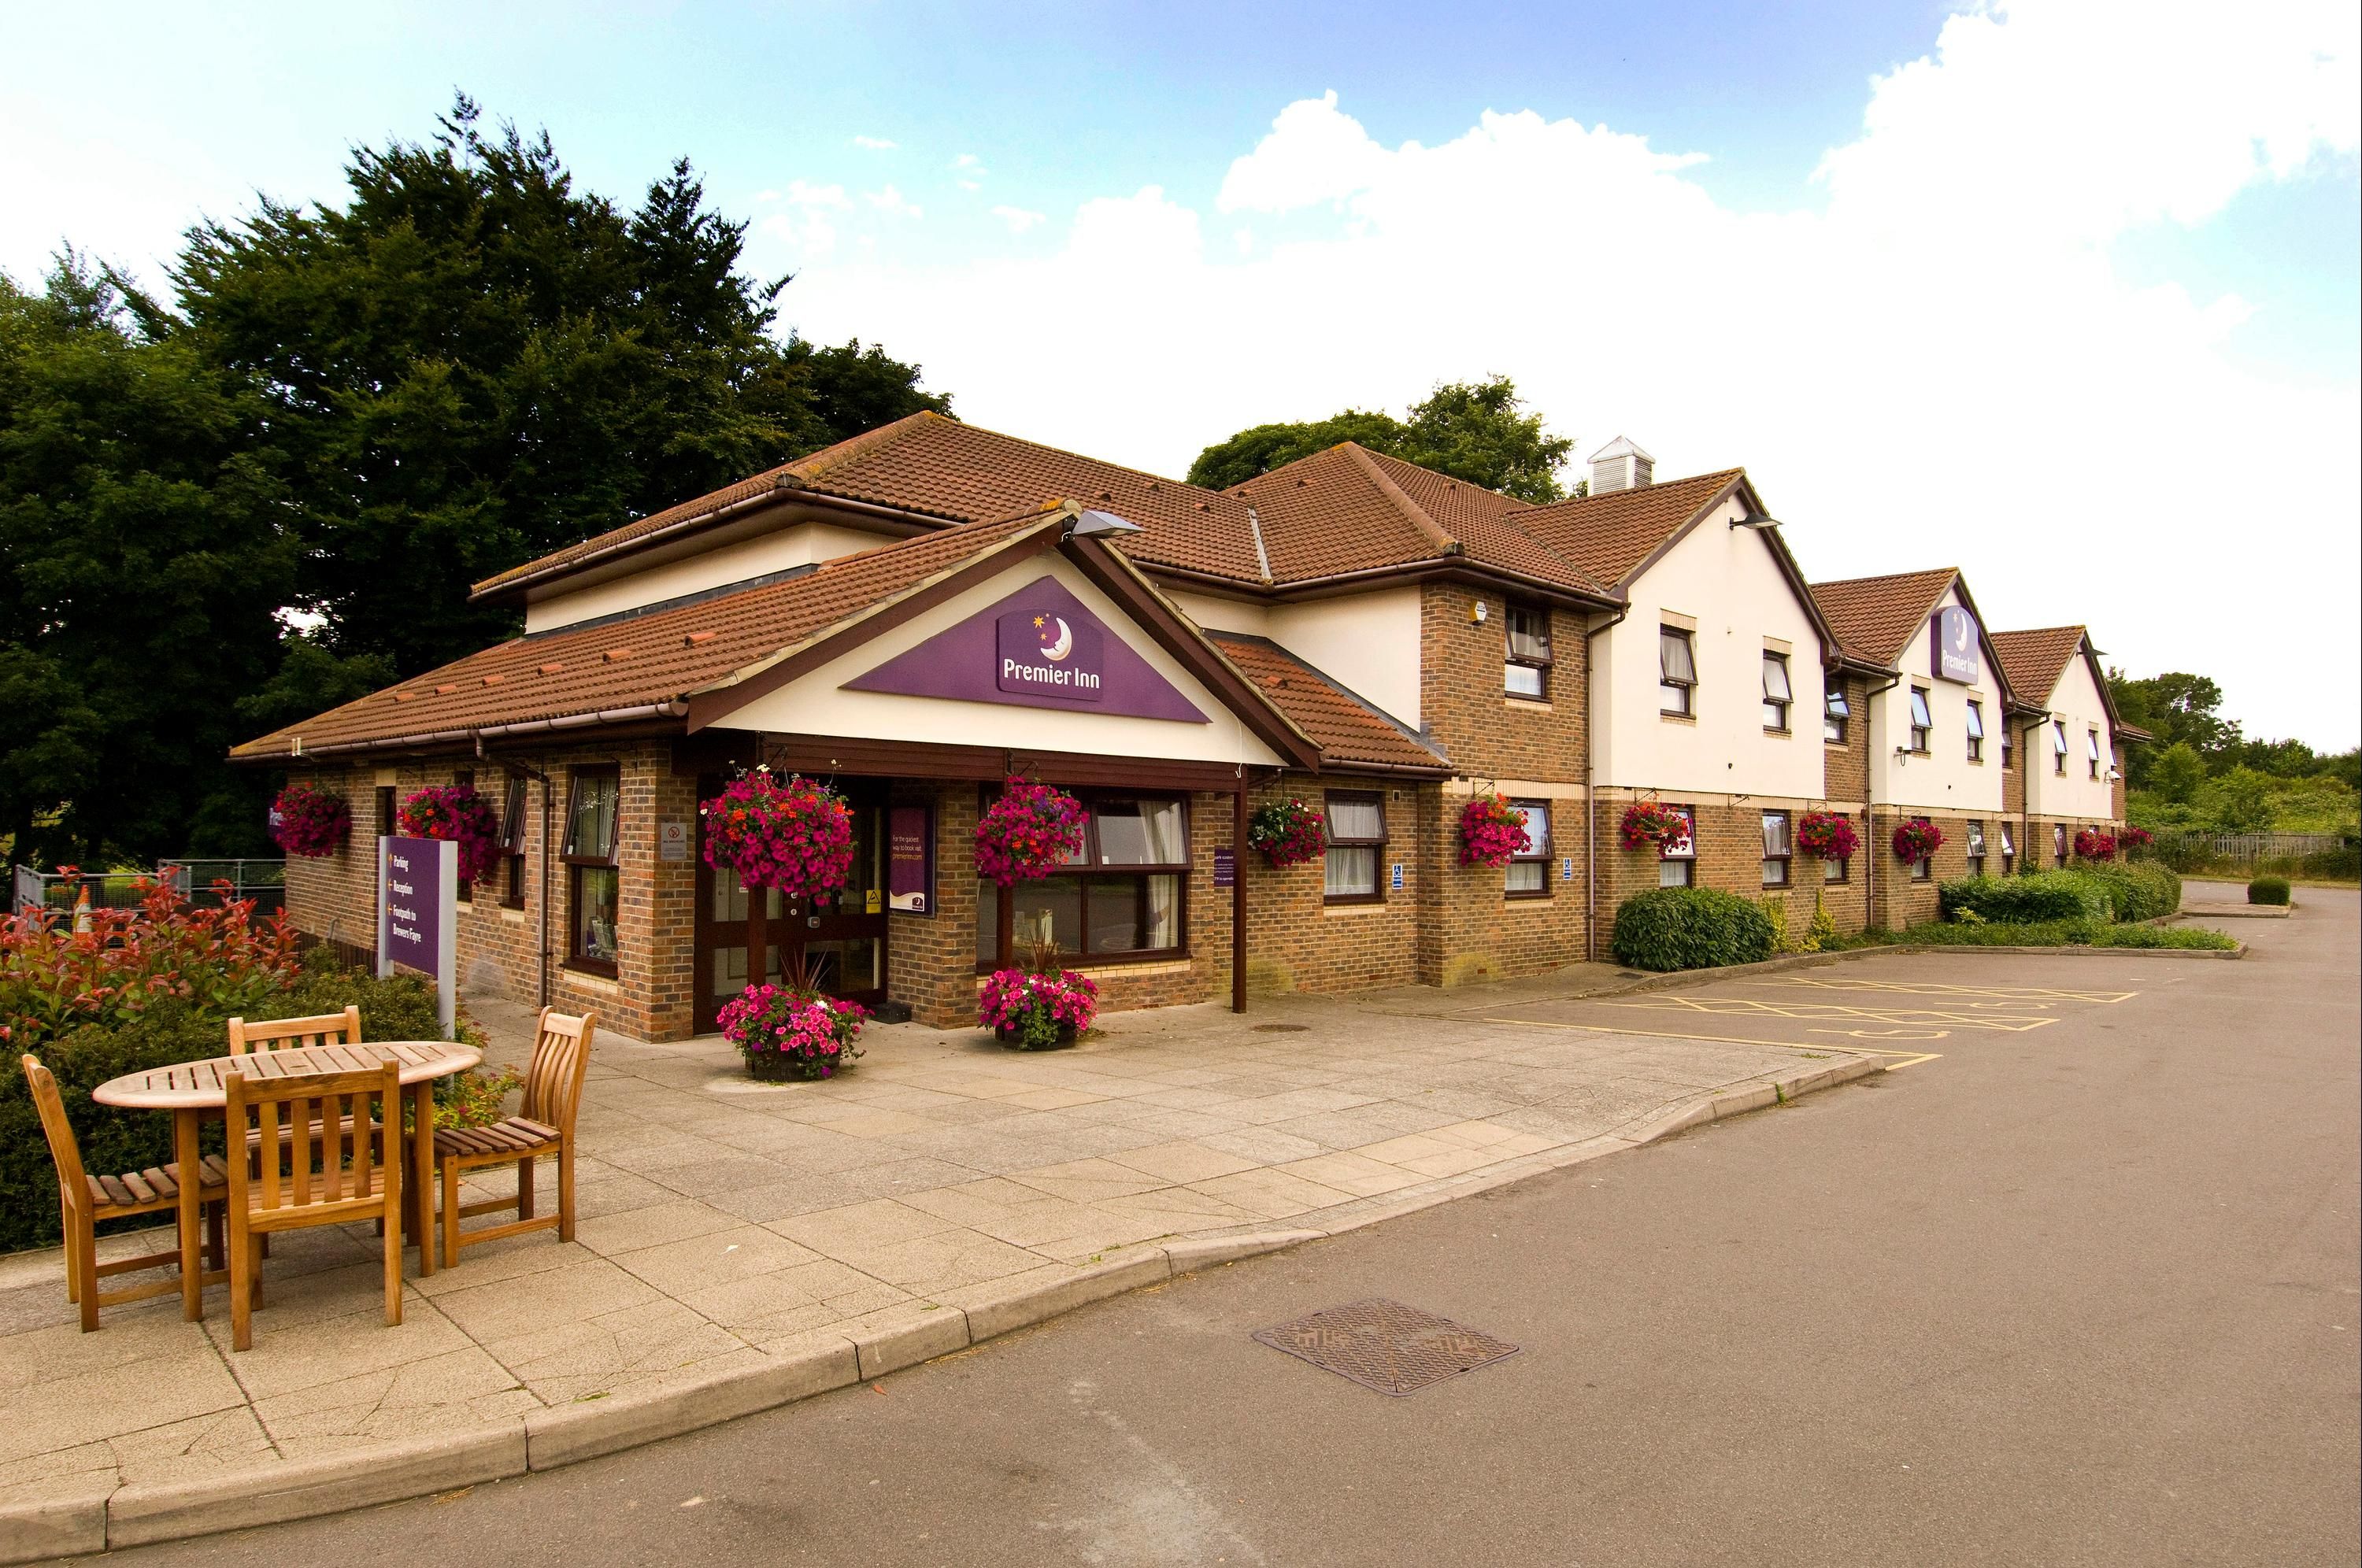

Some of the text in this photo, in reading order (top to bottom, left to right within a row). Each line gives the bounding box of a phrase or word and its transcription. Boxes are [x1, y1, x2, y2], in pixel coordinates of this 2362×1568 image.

[1943, 649, 1977, 675] Premier Inn
[1004, 658, 1100, 689] Premier Inn
[394, 855, 409, 872] Parking
[394, 879, 413, 897] Reception
[394, 904, 416, 921] Footpath to
[393, 923, 421, 944] Brewers Fayre
